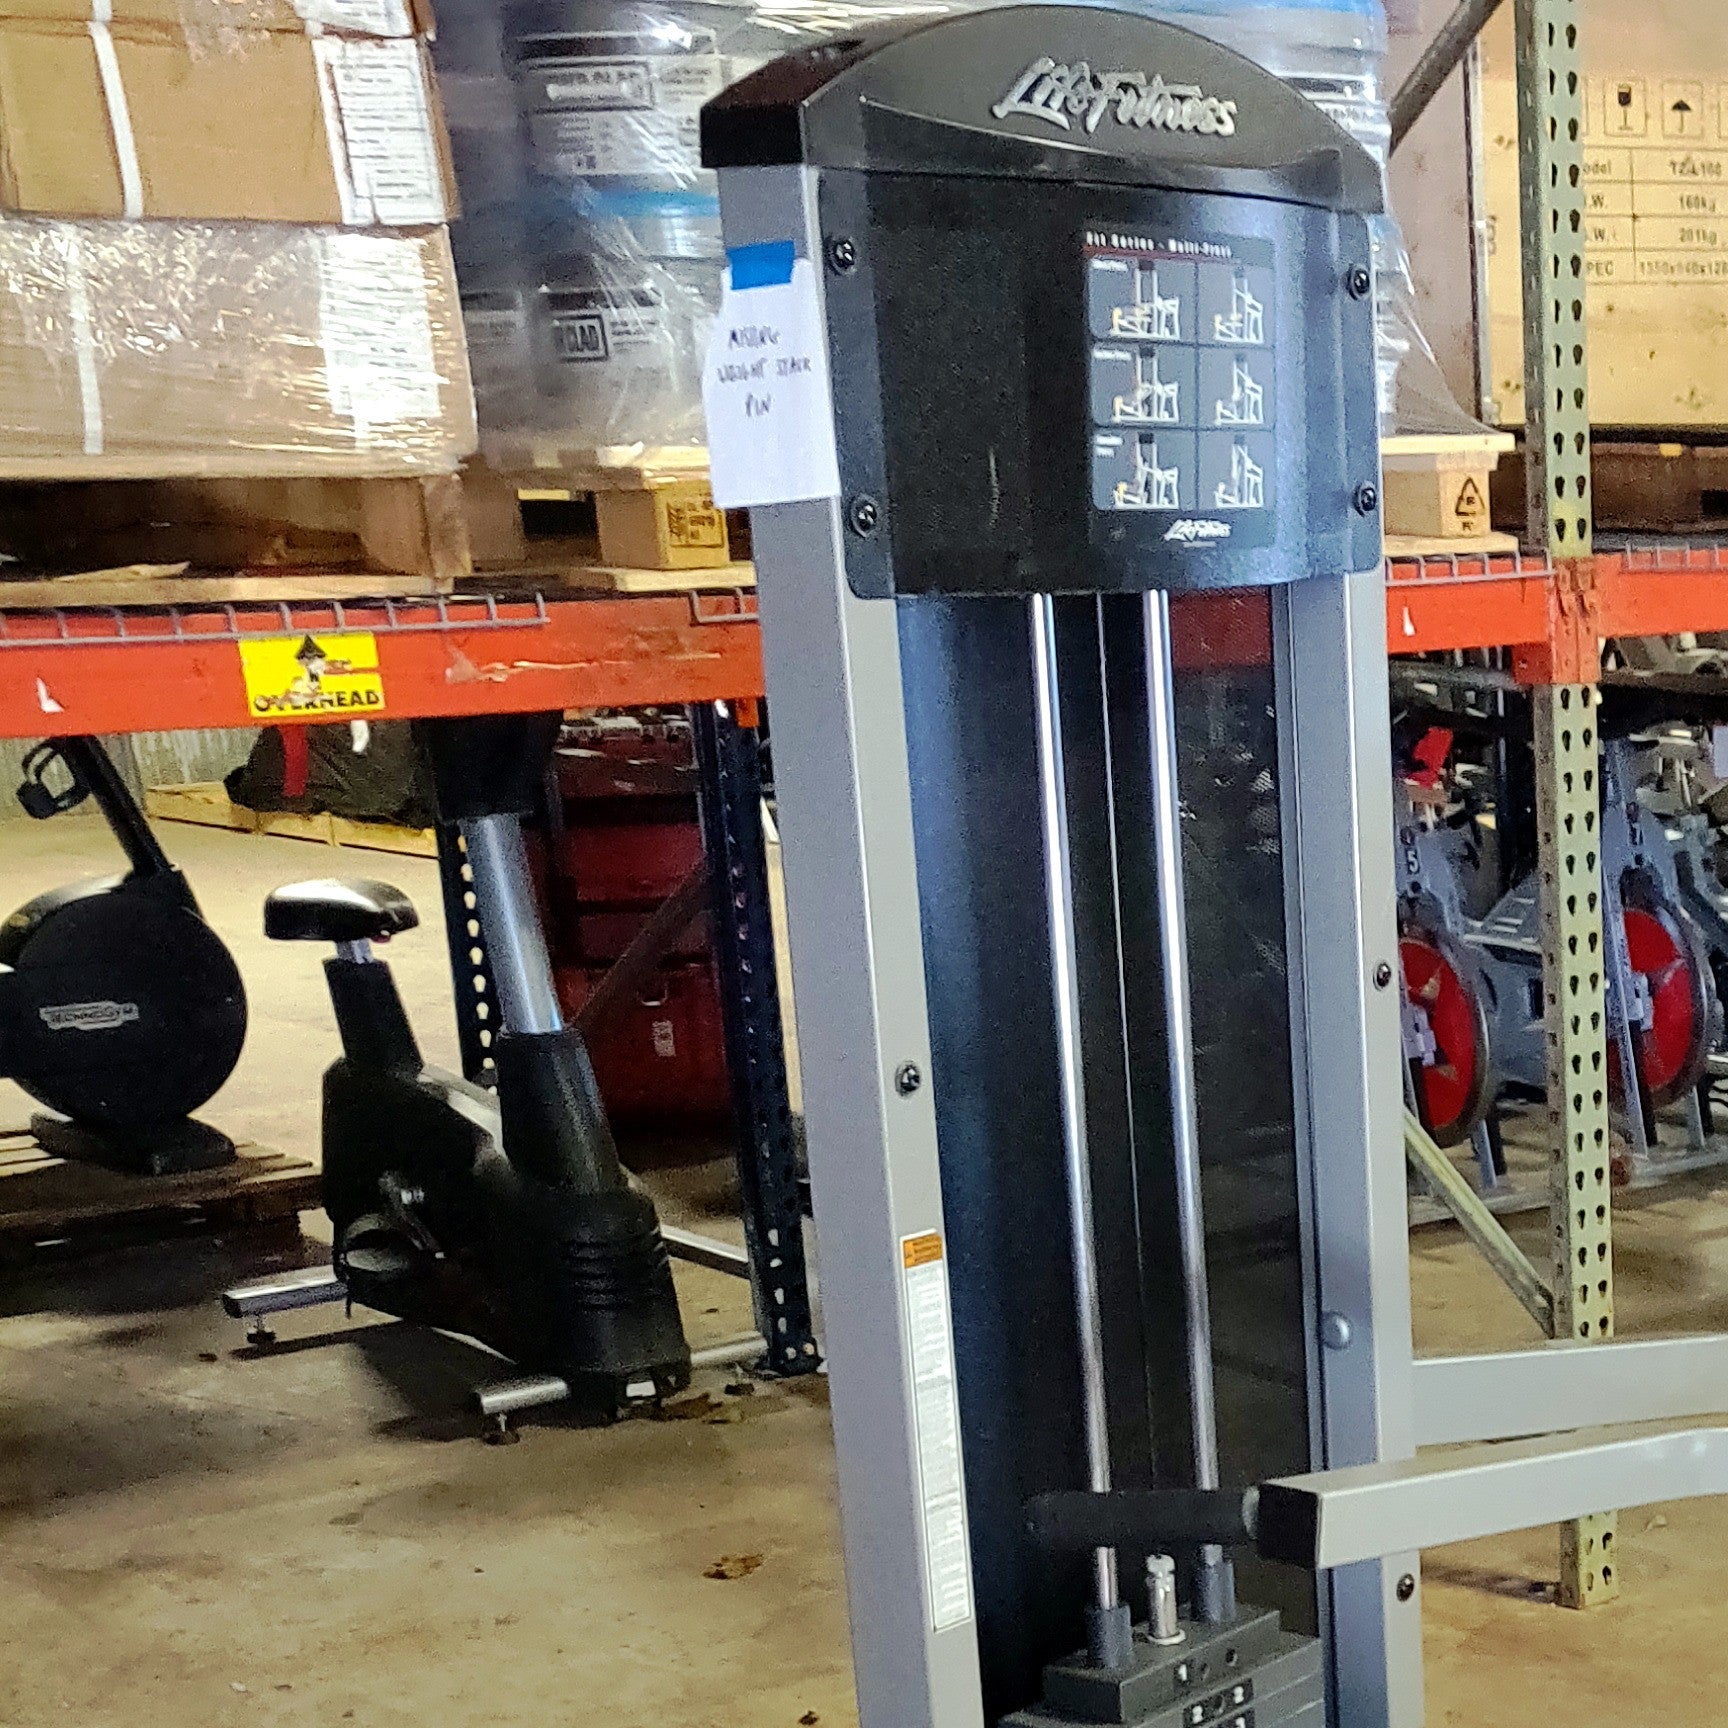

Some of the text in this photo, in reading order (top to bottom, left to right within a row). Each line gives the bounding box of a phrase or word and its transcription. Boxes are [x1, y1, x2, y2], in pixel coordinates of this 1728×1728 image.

[1586, 261, 1614, 276] PEC
[1407, 850, 1419, 873] 5
[1178, 1664, 1187, 1681] 1
[1192, 1686, 1245, 1724] 2 2
